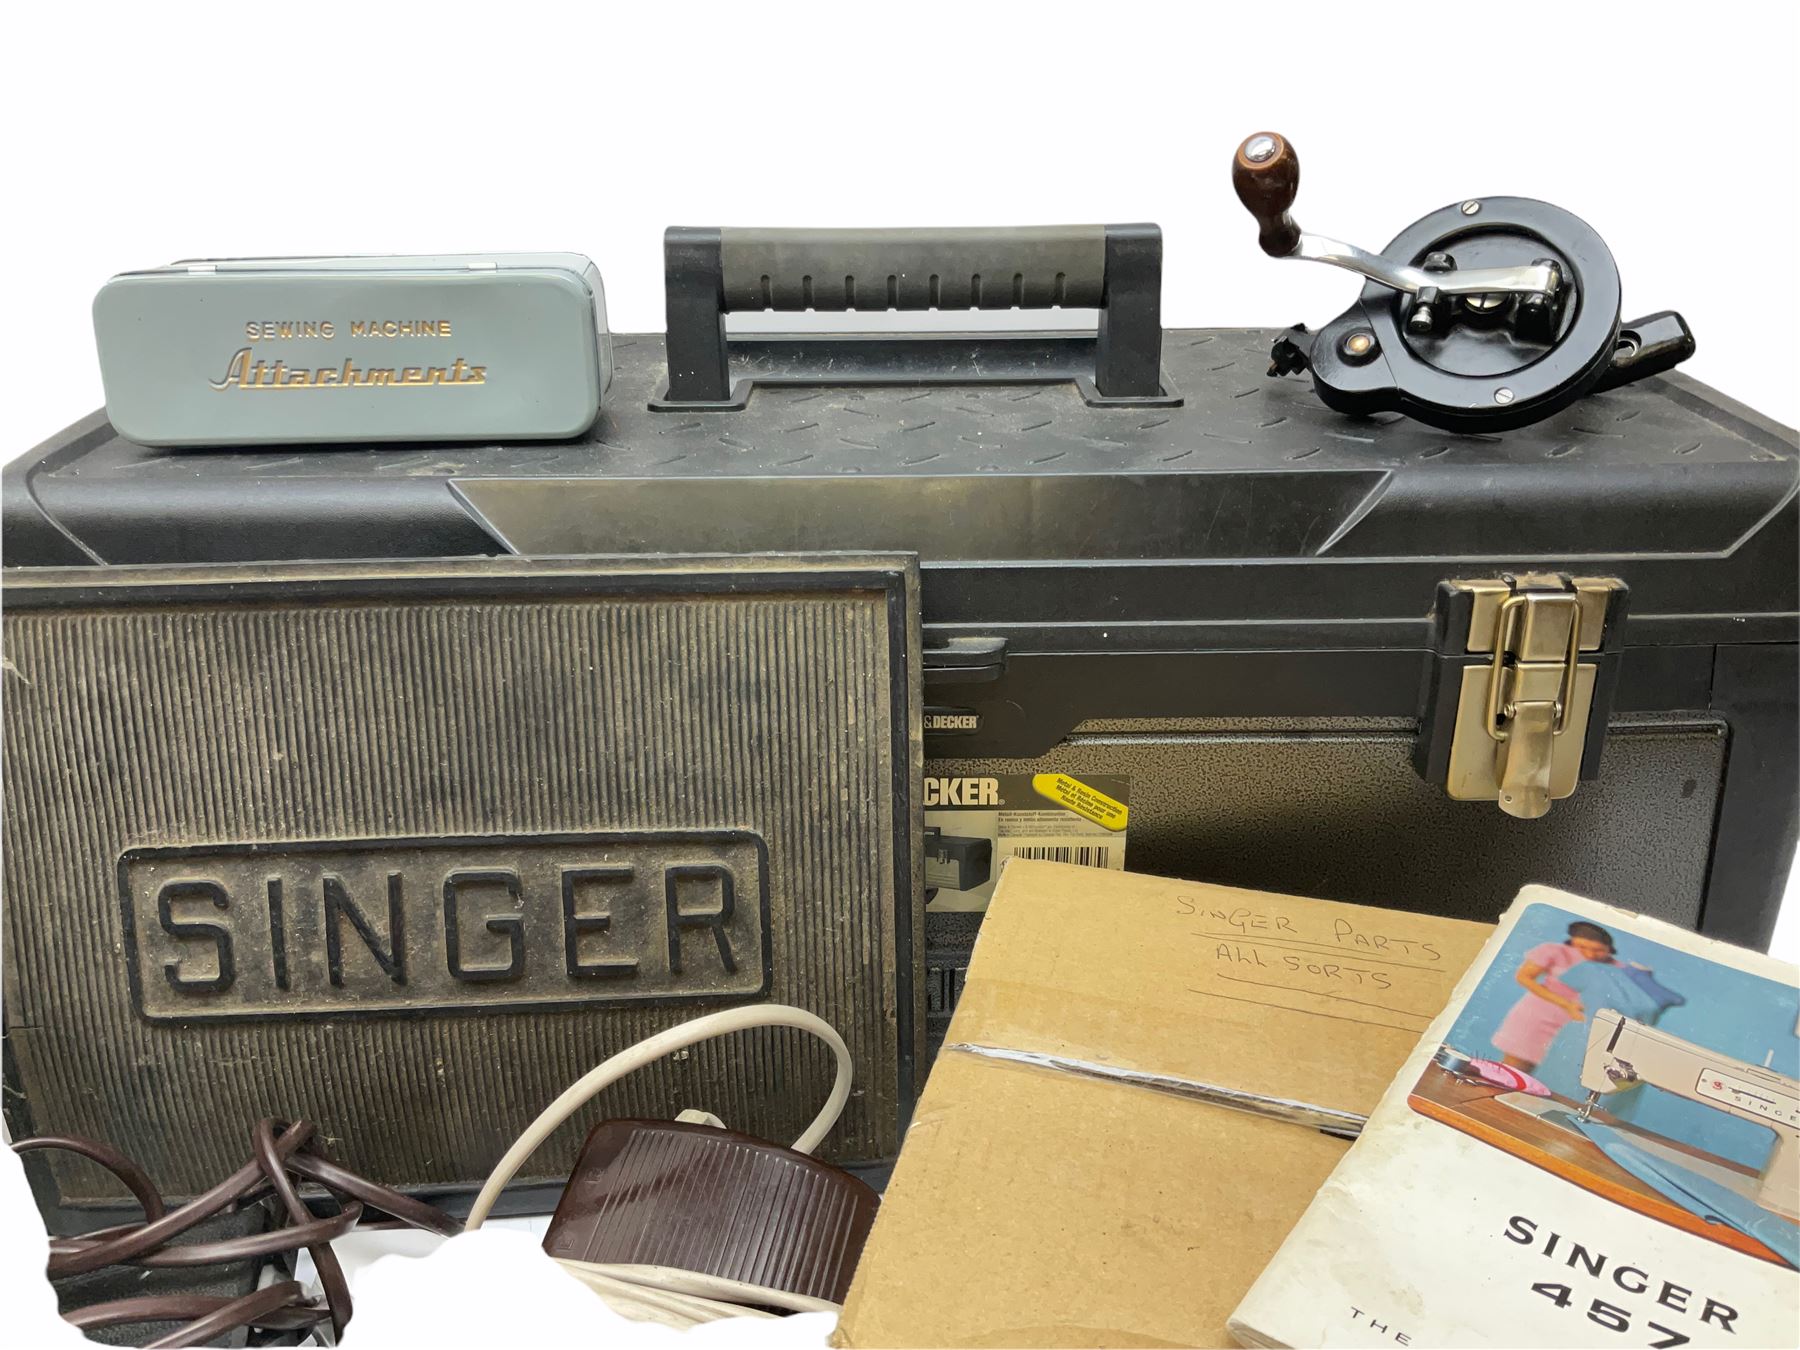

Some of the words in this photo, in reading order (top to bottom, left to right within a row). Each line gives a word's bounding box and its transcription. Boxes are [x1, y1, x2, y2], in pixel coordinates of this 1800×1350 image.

[245, 320, 336, 340] SEWING
[350, 319, 453, 338] MACHINE
[208, 347, 488, 391] Attachments
[156, 864, 739, 993] SINGER
[1216, 943, 1268, 968] ALL
[1283, 955, 1392, 990] SORTS
[1503, 1215, 1739, 1334] SINGER
[1350, 1306, 1412, 1347] THE
[1530, 1282, 1691, 1350] 457
